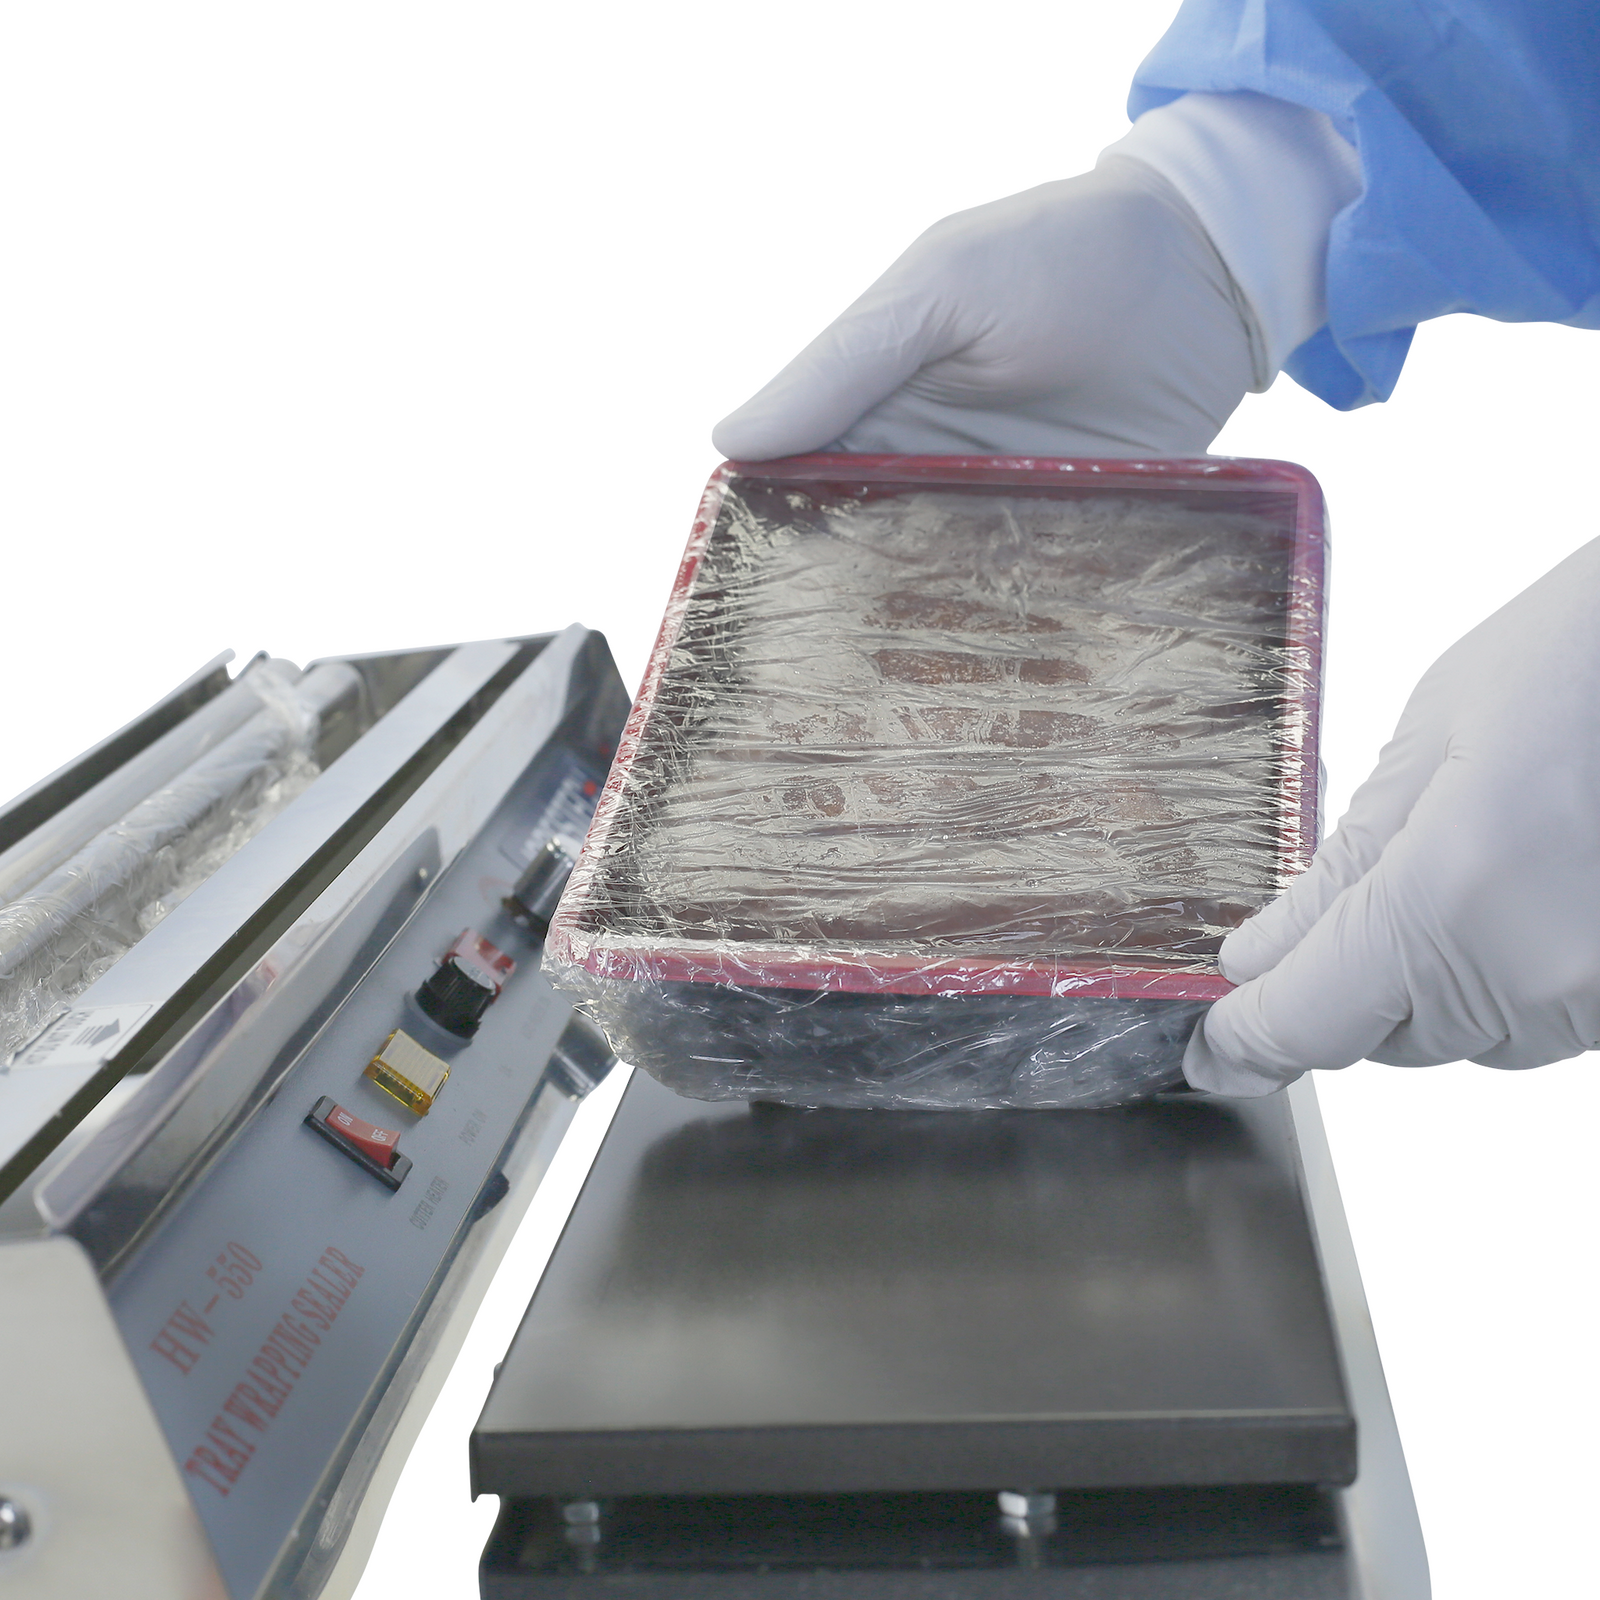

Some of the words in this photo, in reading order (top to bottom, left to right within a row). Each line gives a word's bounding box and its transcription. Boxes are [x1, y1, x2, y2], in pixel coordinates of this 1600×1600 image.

[337, 1111, 354, 1126] ON
[371, 1128, 389, 1142] OFF
[183, 1415, 257, 1498] TRAY
[223, 1312, 322, 1433] WRAPPING
[291, 1246, 366, 1332] SEALER
